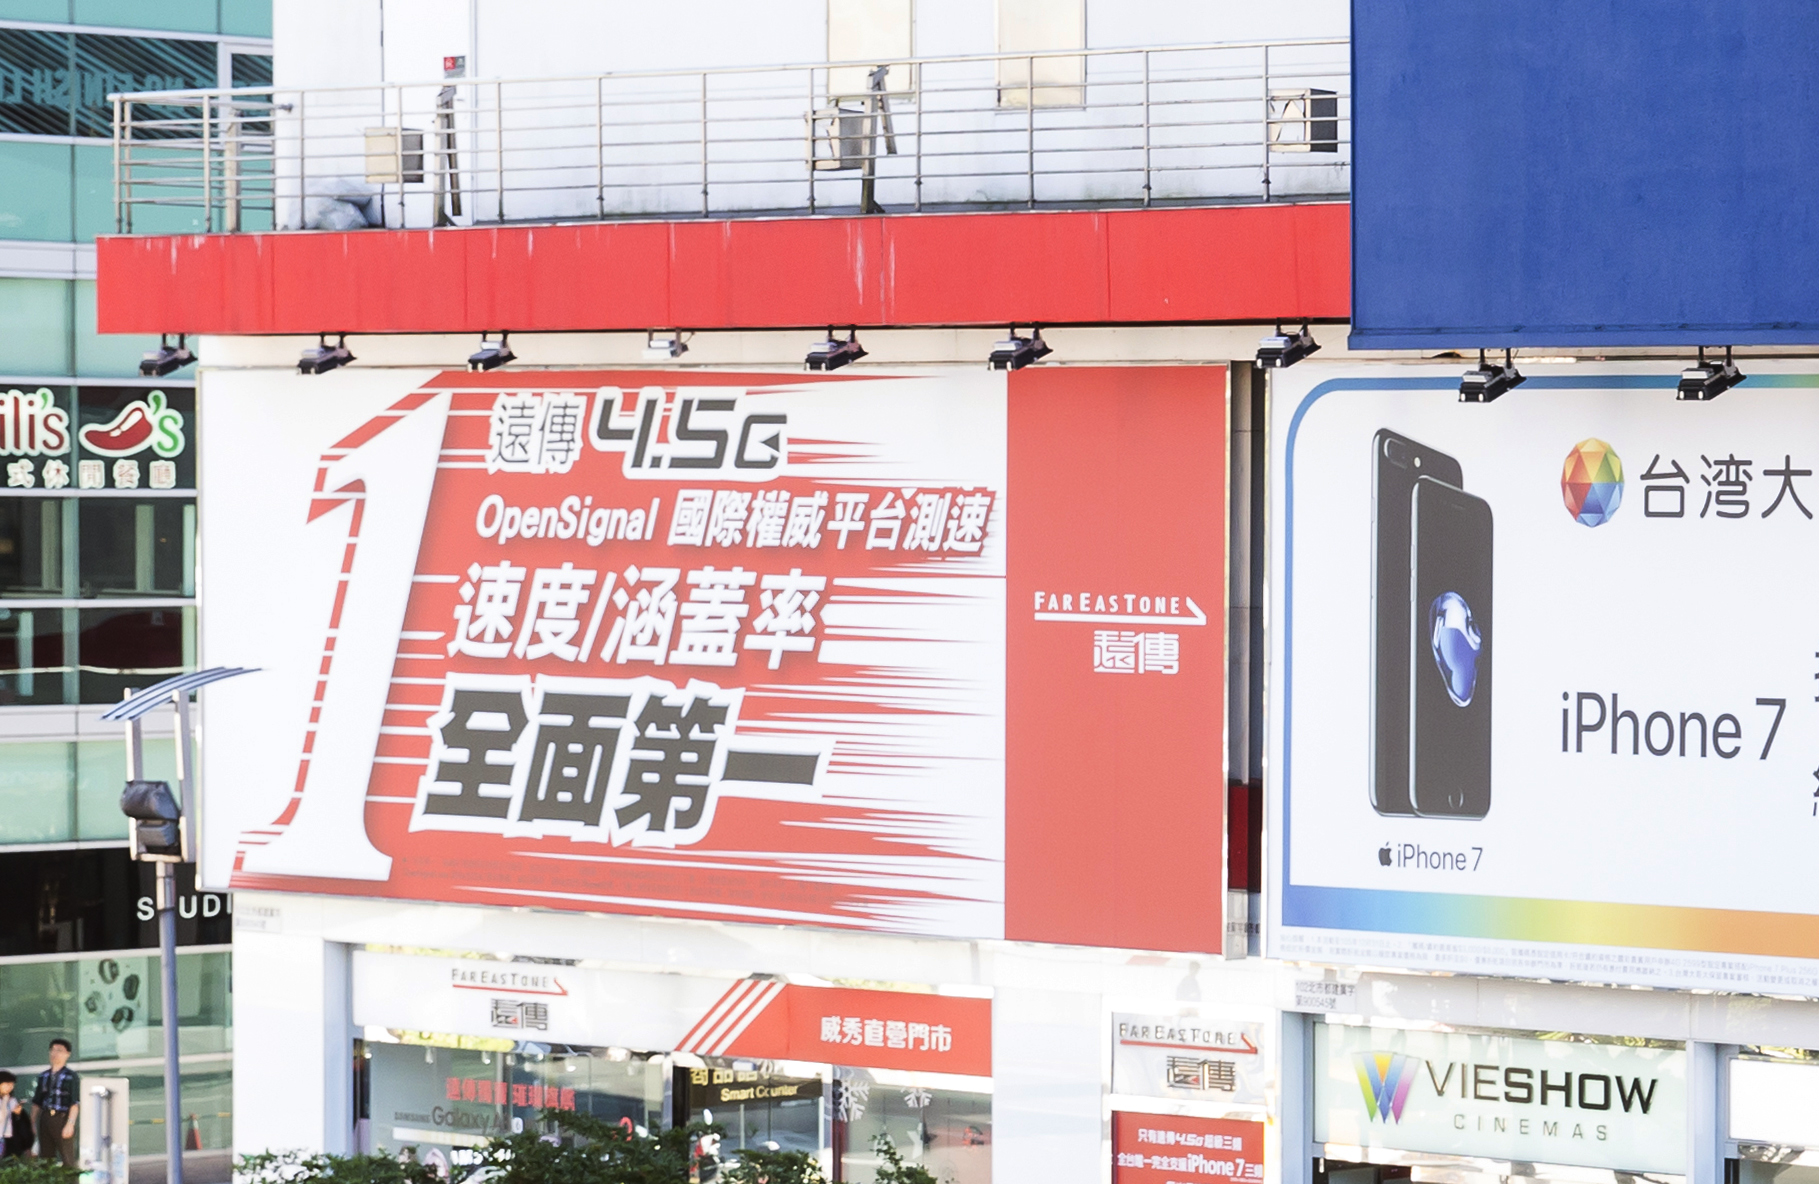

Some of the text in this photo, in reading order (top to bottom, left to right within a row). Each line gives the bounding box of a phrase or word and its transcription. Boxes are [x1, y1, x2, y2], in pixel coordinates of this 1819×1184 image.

[490, 394, 586, 471] 遠傳
[475, 489, 988, 553] OpenSignal 國際權威平台測速
[447, 562, 831, 669] 速度/涵蓋率
[1561, 691, 1787, 761] iPhone 7
[417, 682, 832, 834] 全面第一
[1396, 843, 1483, 872] iPhone 7
[820, 1016, 953, 1052] 威秀直營門市
[720, 1087, 754, 1102] Smart
[1425, 1058, 1658, 1115] VIESHOW
[1454, 1112, 1609, 1142] CINEMAS
